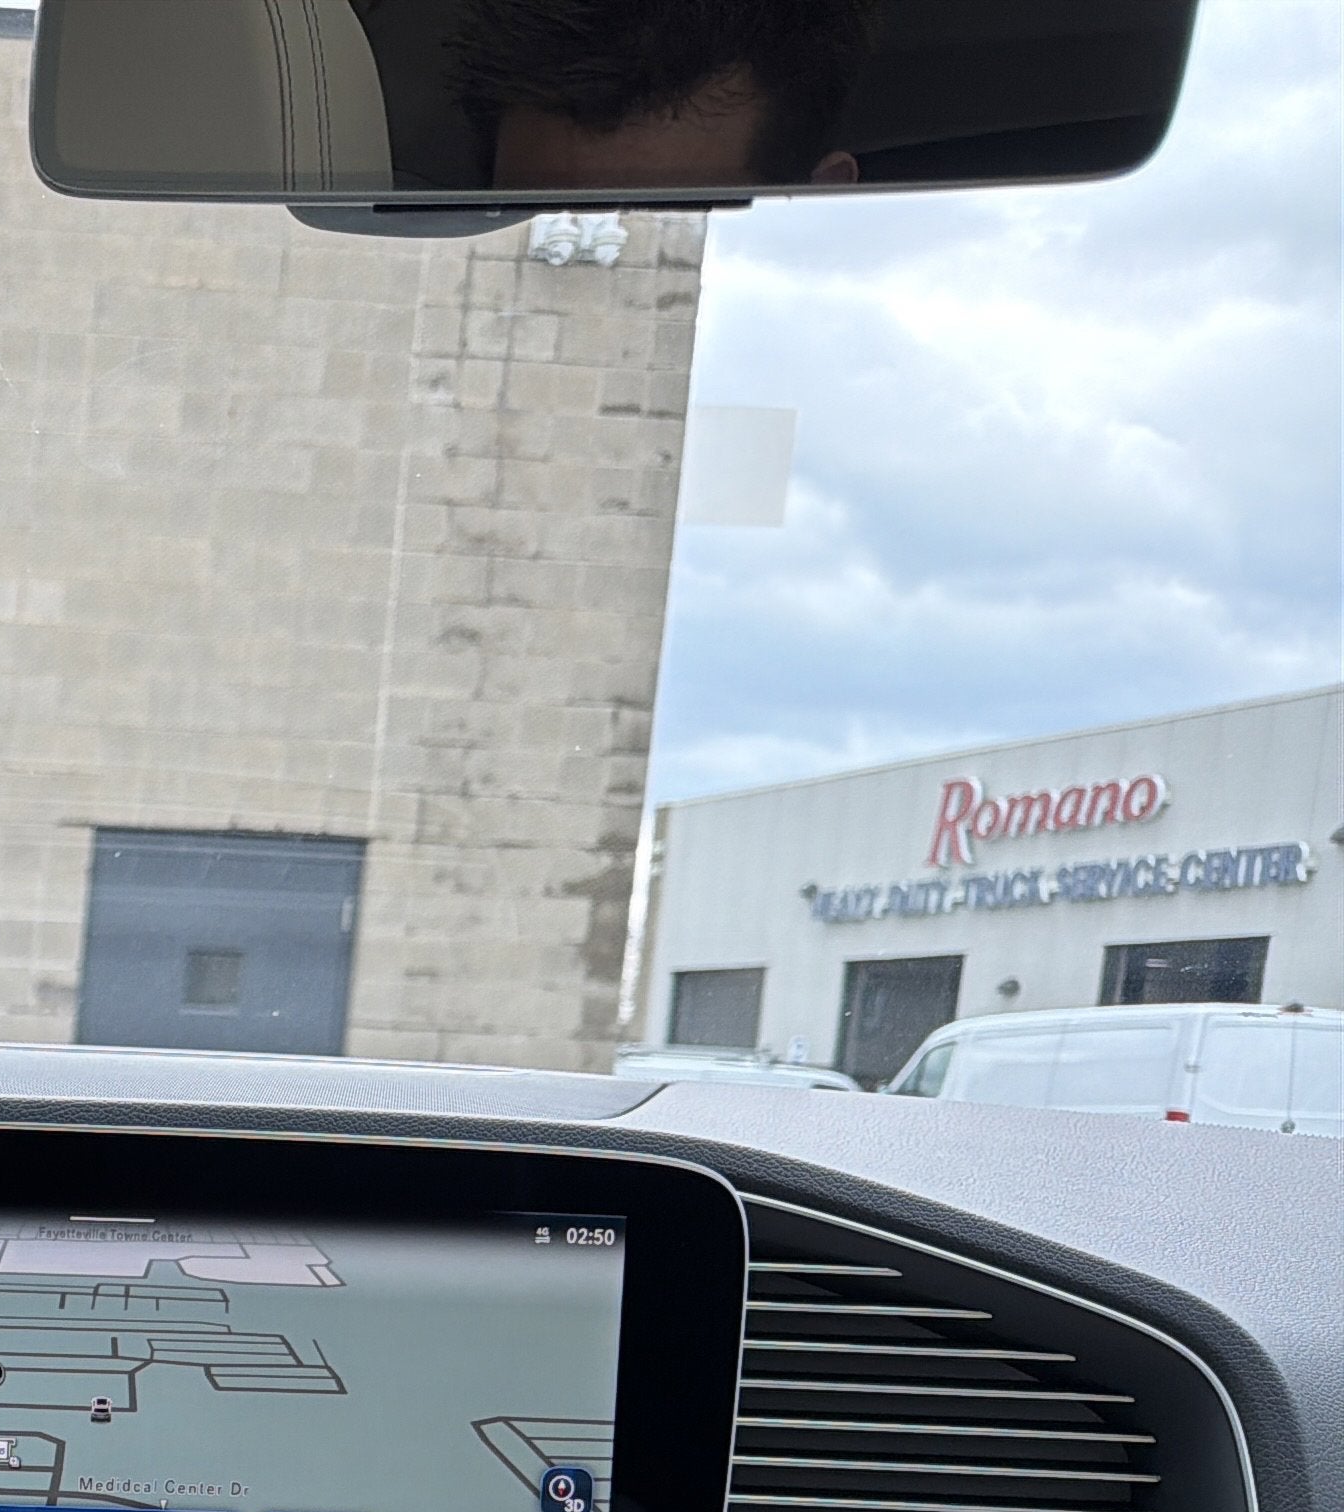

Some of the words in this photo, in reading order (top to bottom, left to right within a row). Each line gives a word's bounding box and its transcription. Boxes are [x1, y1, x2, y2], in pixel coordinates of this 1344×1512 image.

[926, 774, 1169, 867] Romano
[1058, 856, 1175, 902] SERVICE
[1180, 841, 1310, 890] CENTER
[566, 1227, 616, 1246] 02:50
[165, 1480, 222, 1496] Center
[229, 1483, 250, 1498] Dr
